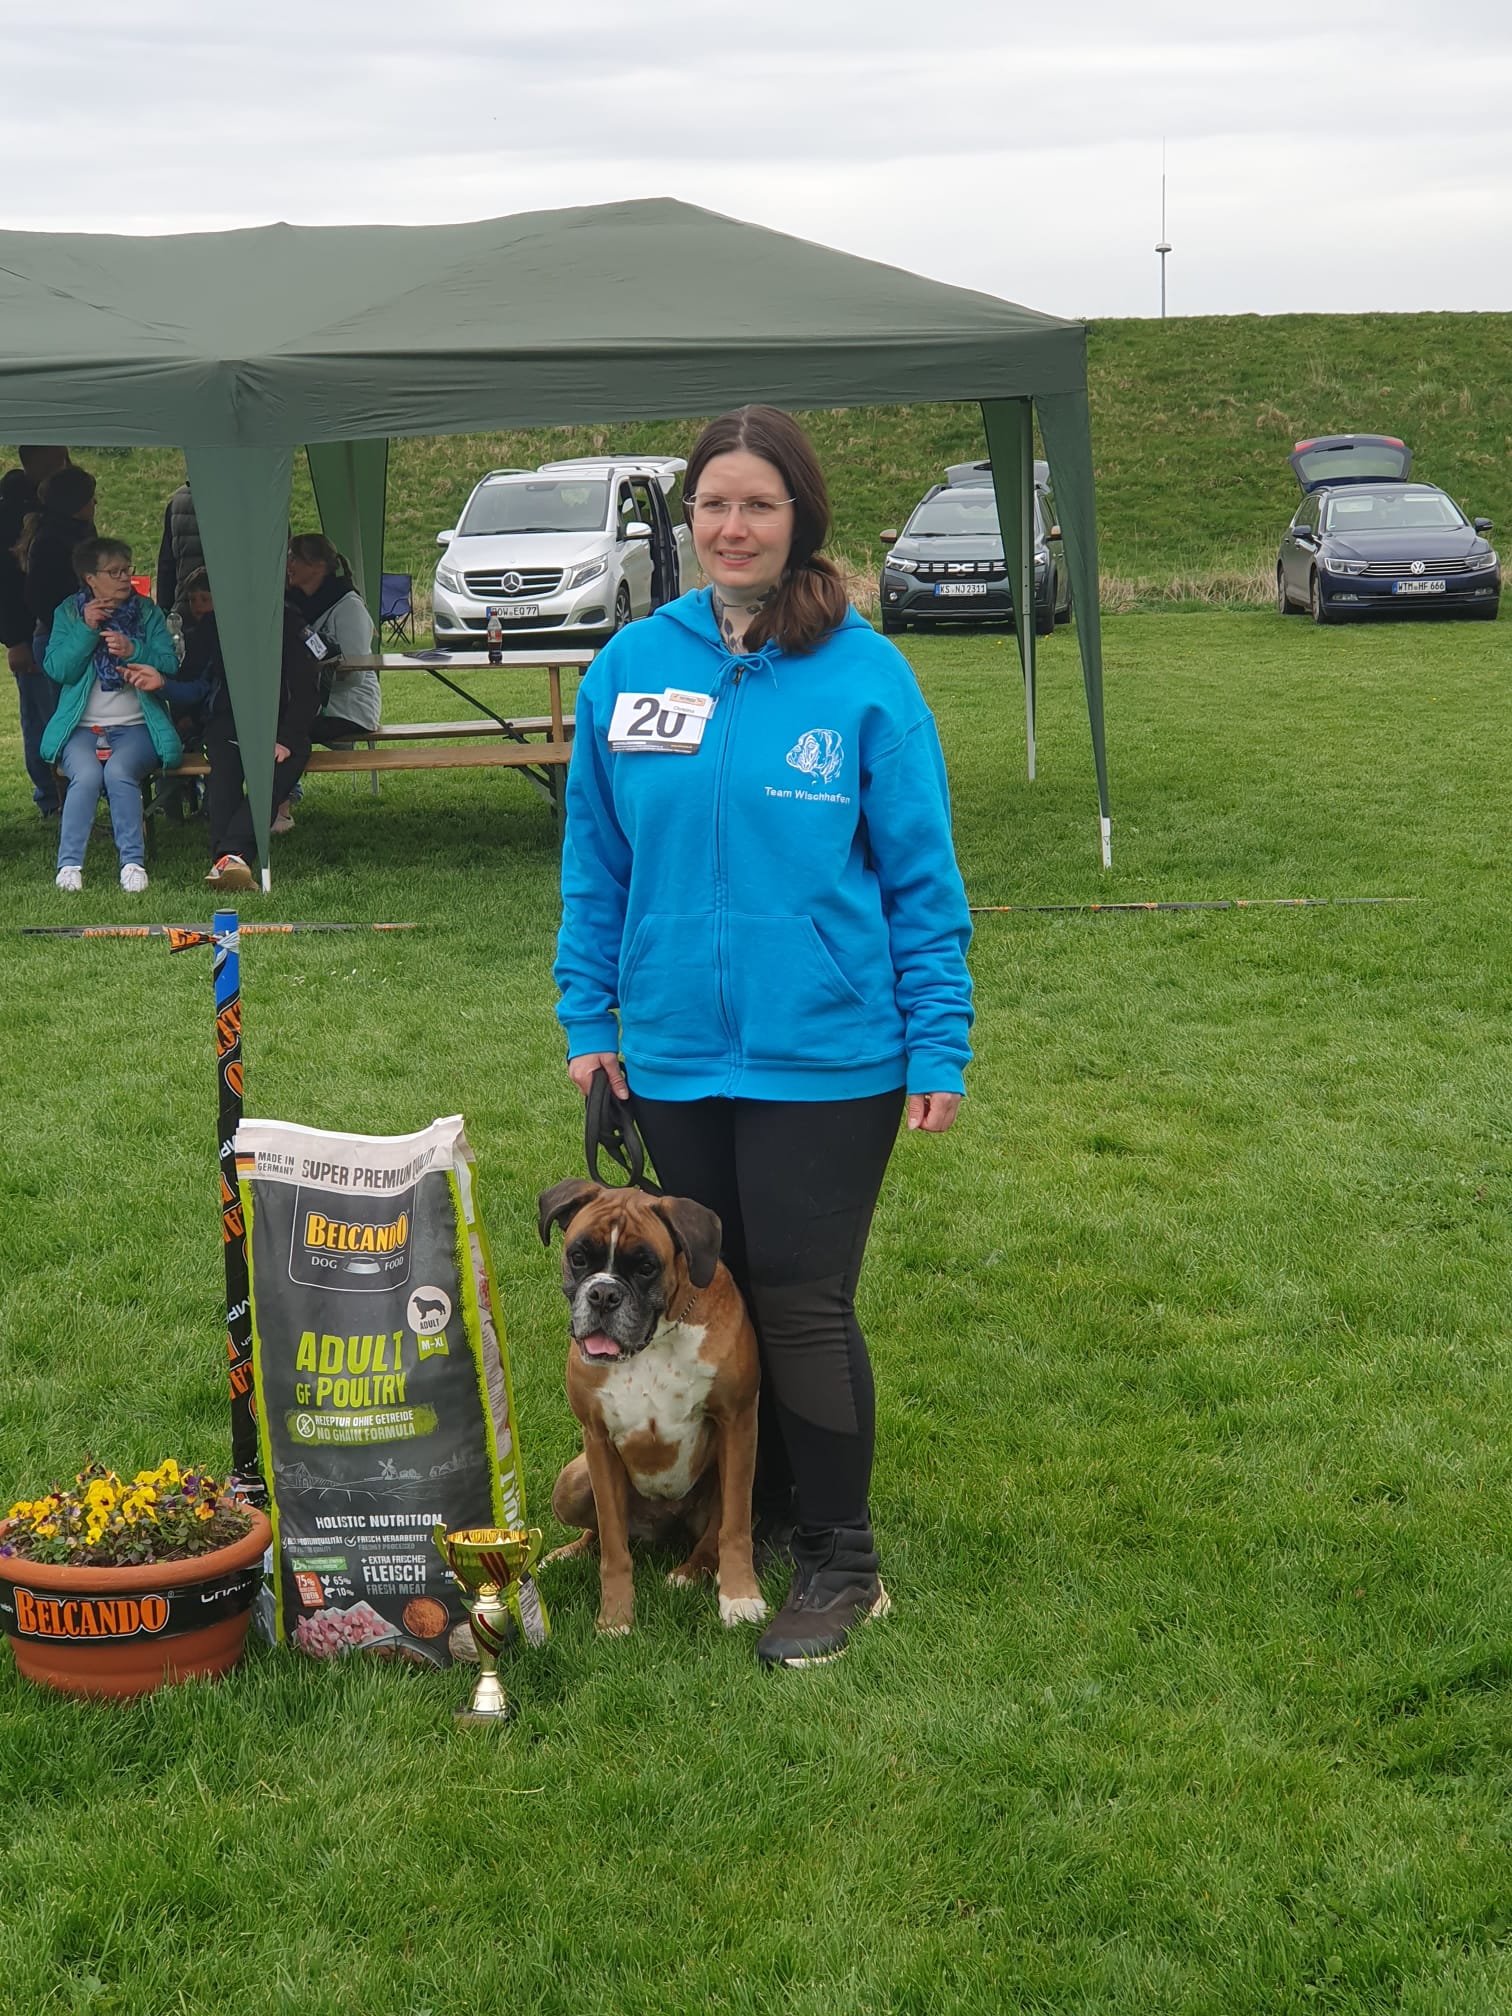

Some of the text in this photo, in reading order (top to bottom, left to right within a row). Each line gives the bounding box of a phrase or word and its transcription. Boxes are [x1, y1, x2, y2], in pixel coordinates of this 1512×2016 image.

[1398, 583, 1413, 591] WTM
[1431, 581, 1444, 590] 666
[627, 697, 687, 738] 20
[764, 786, 792, 798] Team
[258, 1151, 295, 1166] MADE IN
[257, 1162, 294, 1176] GERMANY
[302, 1159, 349, 1187] SUPER
[353, 1161, 412, 1189] PREMIUM
[304, 1211, 408, 1254] BELCANDO
[311, 1256, 338, 1269] DOG
[384, 1257, 404, 1271] FOOD
[420, 1318, 440, 1330] ADULT
[296, 1330, 403, 1375] ADULT
[296, 1372, 407, 1408] GF POULTRY
[352, 1415, 375, 1427] OHNE
[375, 1410, 414, 1425] GETREIDE
[316, 1422, 416, 1442] NO GRAIN FORMULA
[315, 1513, 442, 1529] HOLISTIC NUTRITION
[368, 1555, 391, 1564] EXTRA
[392, 1554, 426, 1563] FRISCHES
[362, 1564, 426, 1582] FLEISCH
[366, 1583, 426, 1595] FRESH MEAT
[14, 1587, 169, 1638] BELCANDO
